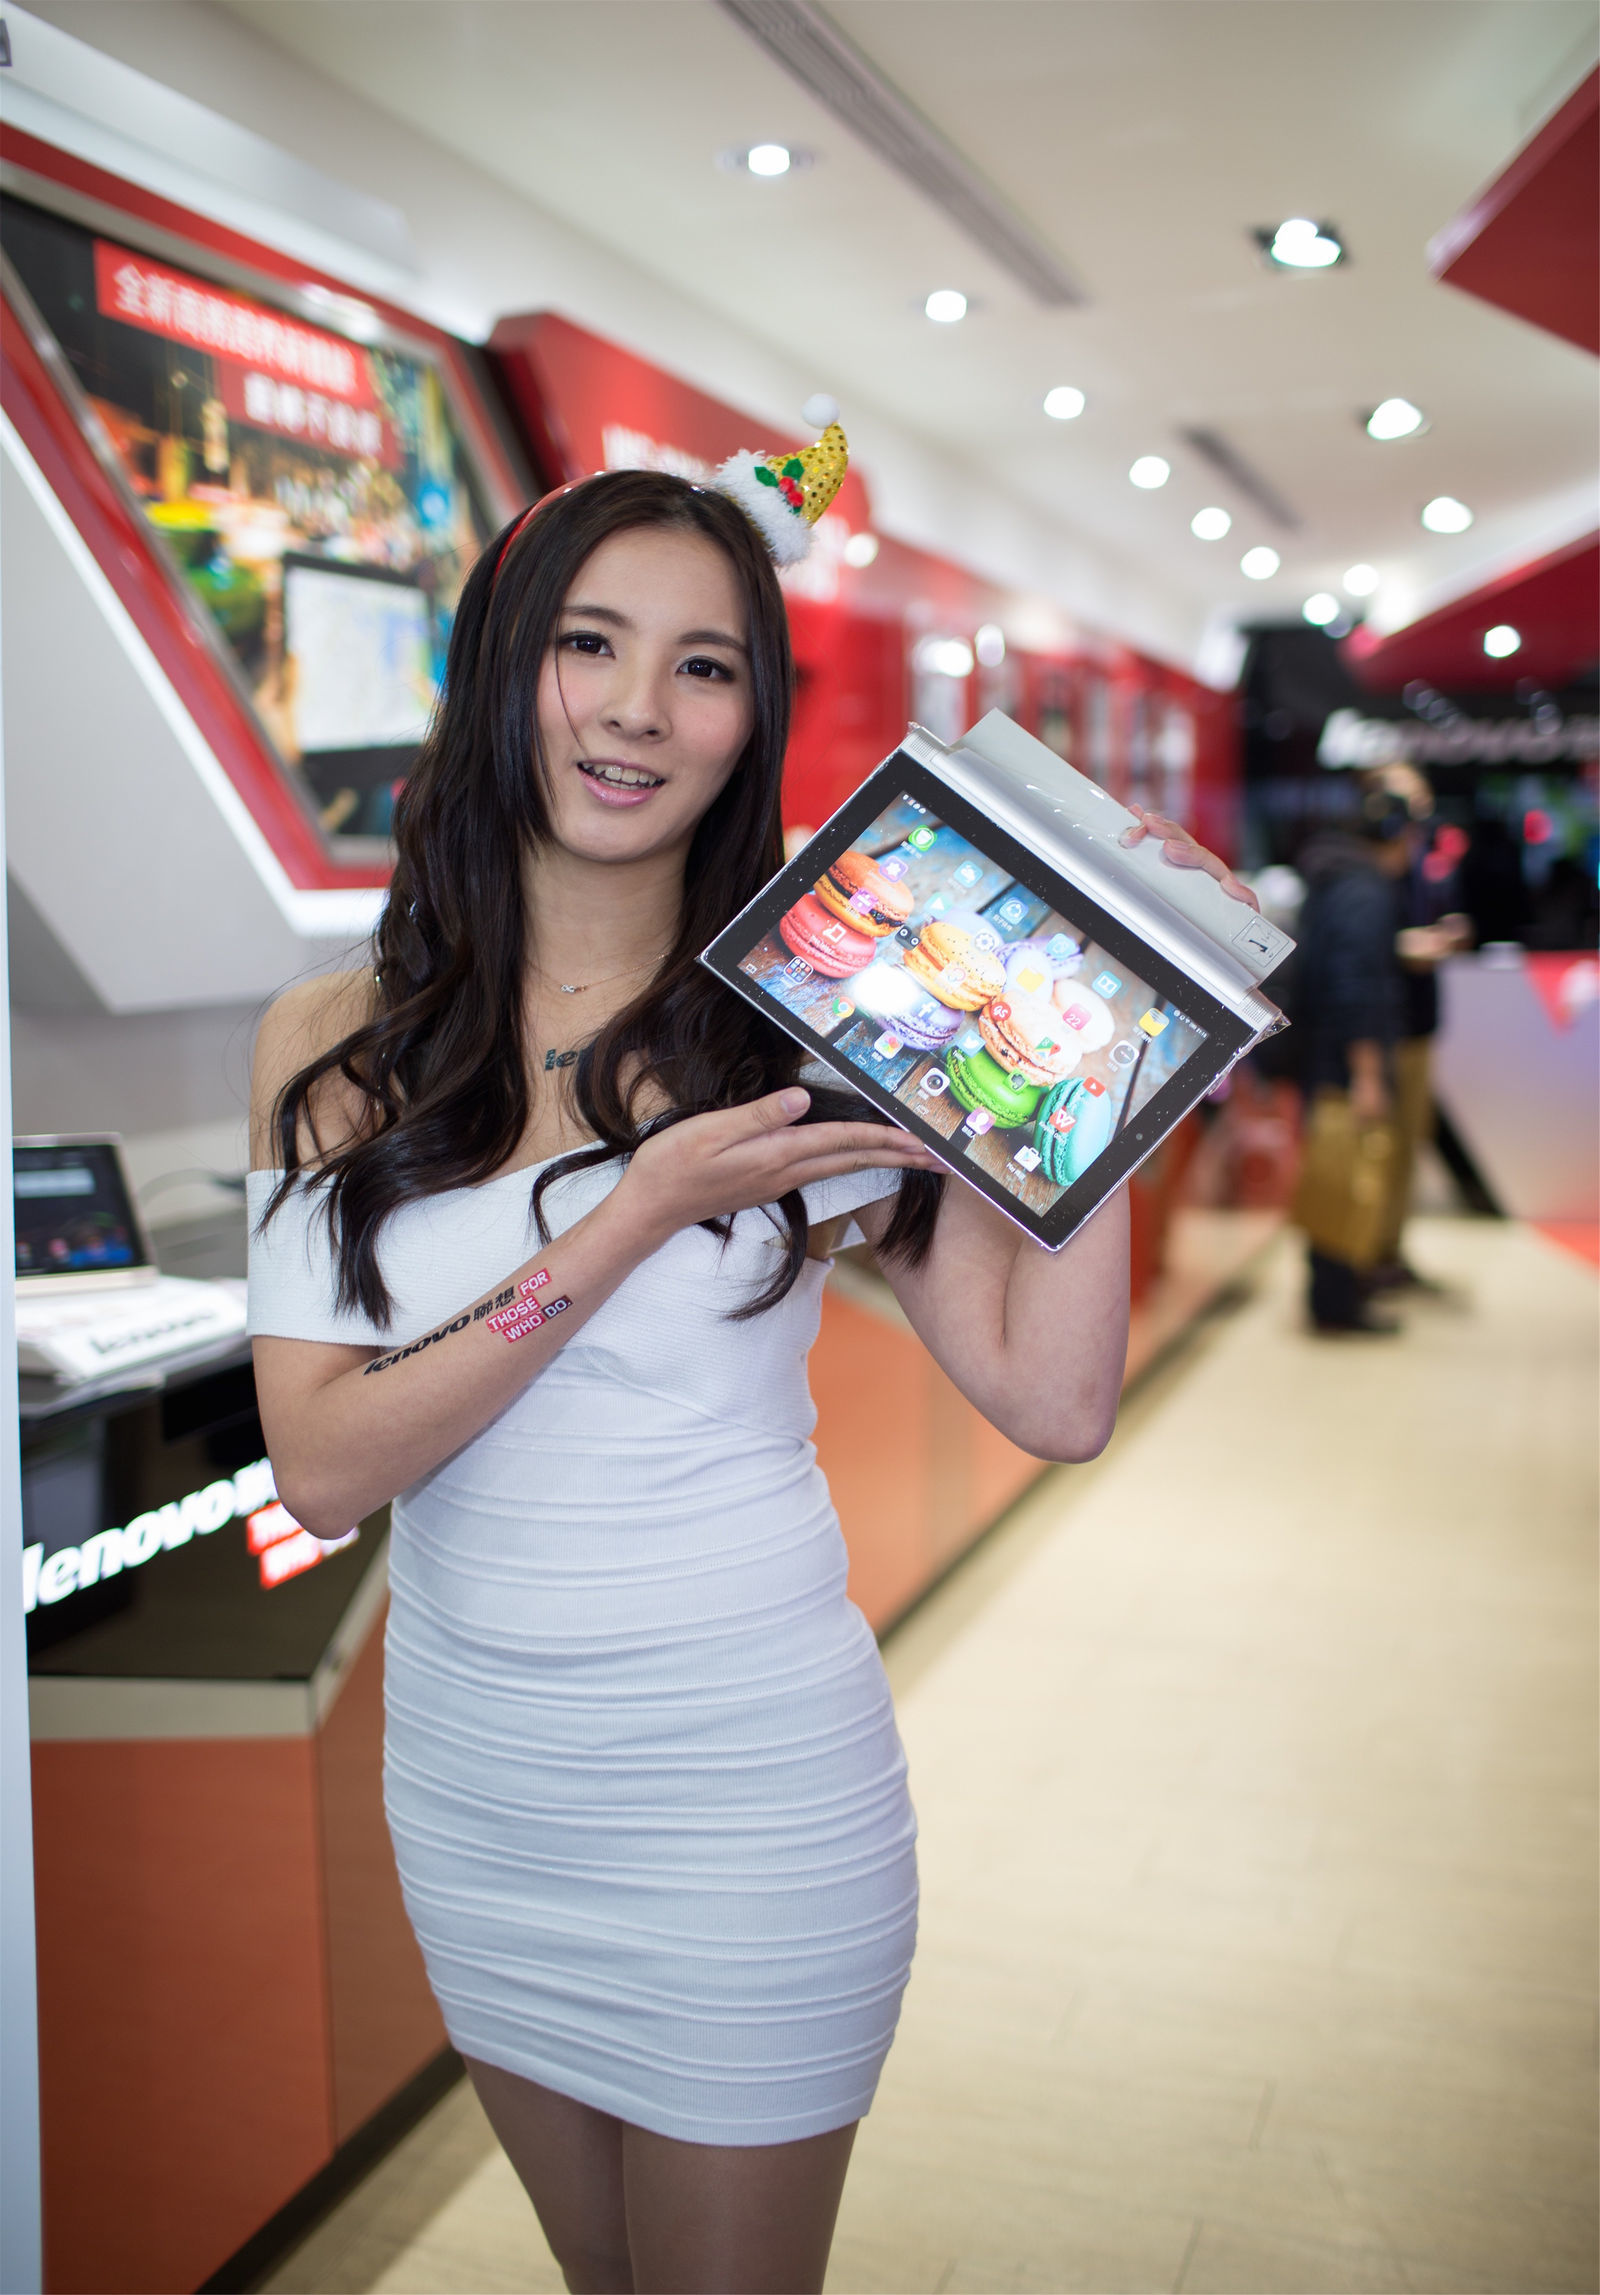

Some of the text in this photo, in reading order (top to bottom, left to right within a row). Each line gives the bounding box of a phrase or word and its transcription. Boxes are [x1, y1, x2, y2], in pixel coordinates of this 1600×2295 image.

[1065, 1013, 1082, 1028] 22
[520, 1271, 549, 1296] FOR
[363, 1286, 516, 1376] lenovo 聯想
[489, 1297, 538, 1331] THOSE
[505, 1299, 571, 1341] WHO DO.
[23, 1479, 236, 1614] lenovo
